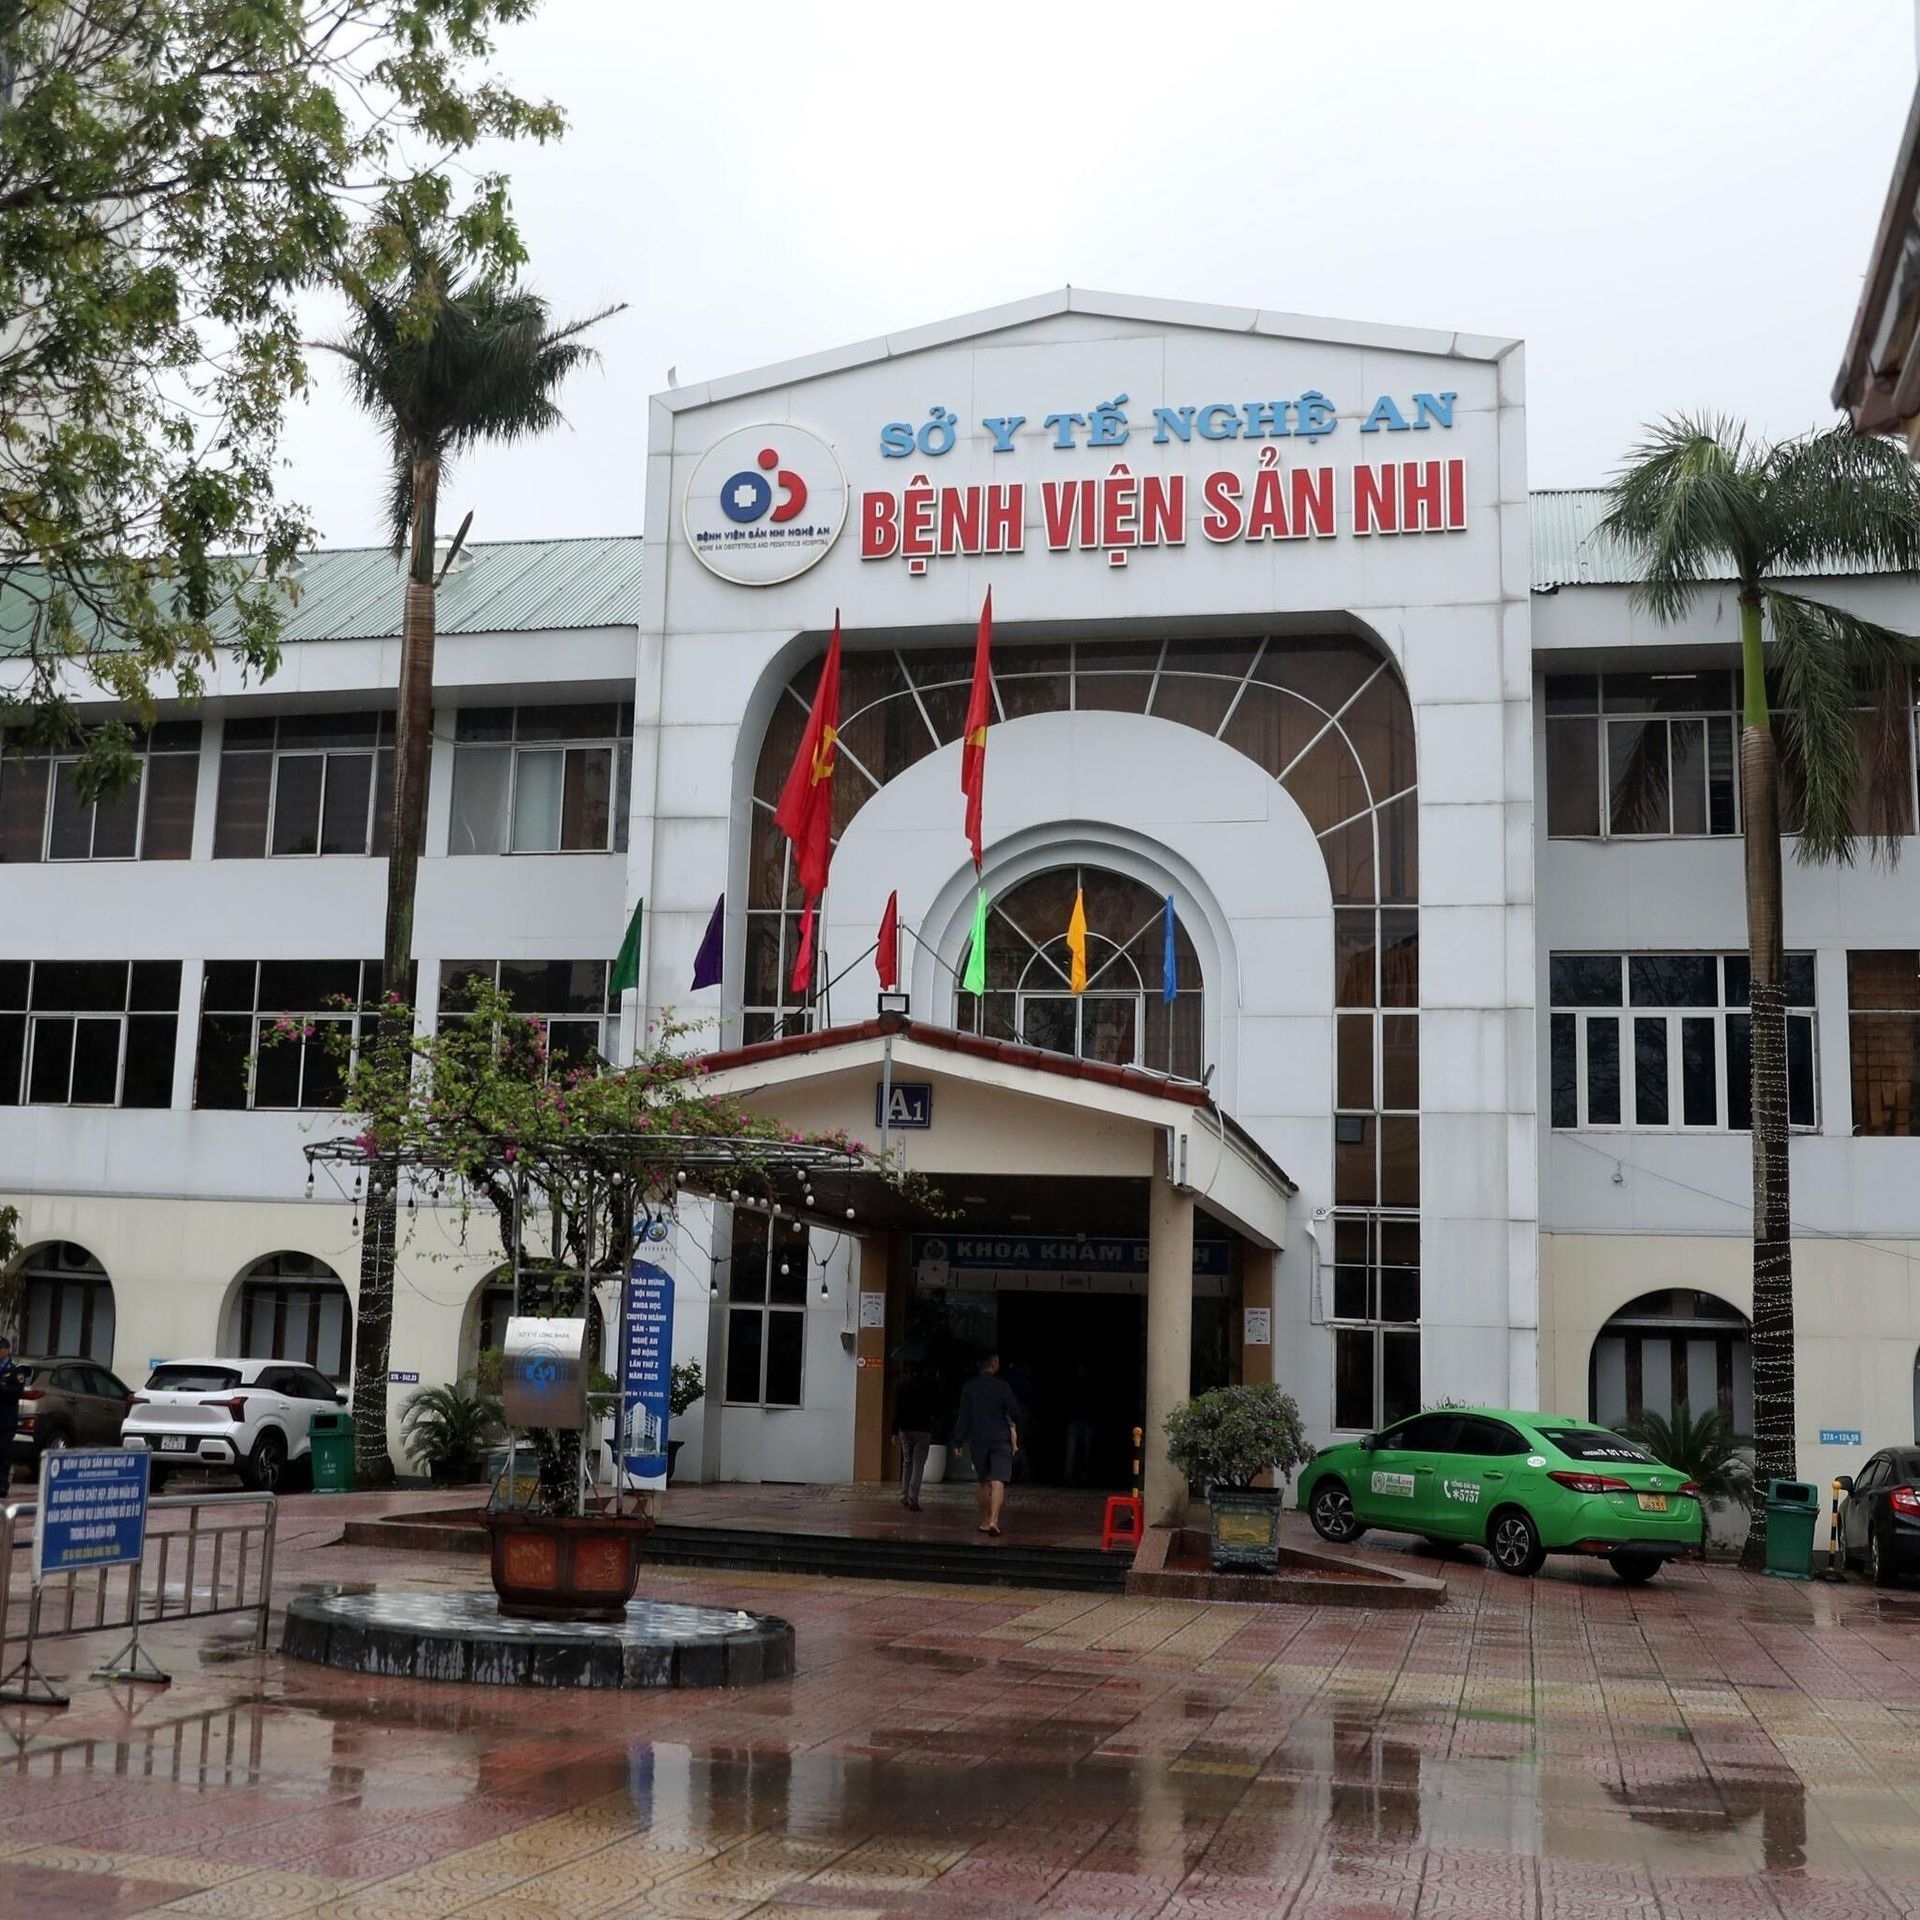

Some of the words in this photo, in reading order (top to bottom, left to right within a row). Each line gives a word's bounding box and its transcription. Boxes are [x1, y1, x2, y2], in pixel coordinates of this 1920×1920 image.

[880, 406, 957, 458] SỞ
[982, 416, 1025, 453] Y
[1044, 393, 1130, 449] TẾ
[1153, 390, 1338, 445] NGHỆ
[1360, 391, 1458, 433] AN
[860, 474, 1025, 575] BỆNH
[1041, 463, 1186, 567] VIỆN
[1202, 445, 1337, 544] SẢN
[1352, 458, 1468, 536] NHI
[697, 531, 722, 543] BỆNH
[724, 528, 746, 541] VIỆN
[769, 527, 785, 538] NHI
[788, 525, 814, 538] NGHỆ
[817, 526, 831, 536] AN
[886, 1088, 924, 1121] A1
[957, 1241, 1030, 1259] KHOA
[1041, 1241, 1122, 1262] KHÁM
[1134, 1246, 1211, 1263] BH
[644, 1372, 659, 1380] 2025
